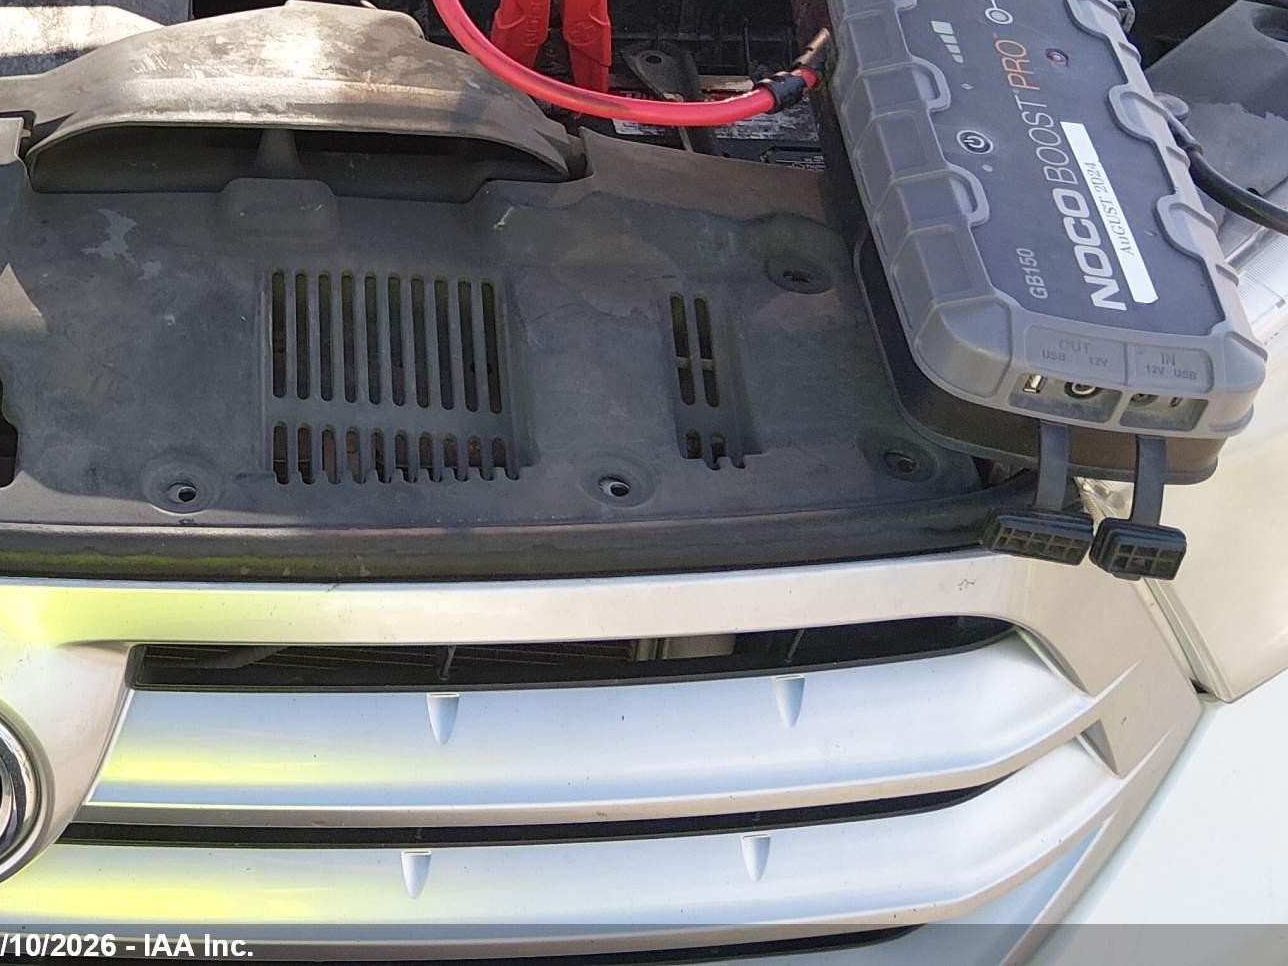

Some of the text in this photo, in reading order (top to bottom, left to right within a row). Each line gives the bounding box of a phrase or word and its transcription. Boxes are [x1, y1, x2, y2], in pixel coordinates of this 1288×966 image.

[995, 39, 1128, 311] NOCO BOOST PRO
[1084, 162, 1135, 256] AUGUST 2024
[1016, 247, 1049, 299] GB150
[1058, 340, 1091, 354] OUT
[1042, 348, 1109, 367] USB 12V
[1161, 353, 1175, 366] IN
[1146, 363, 1198, 380] 12V USB
